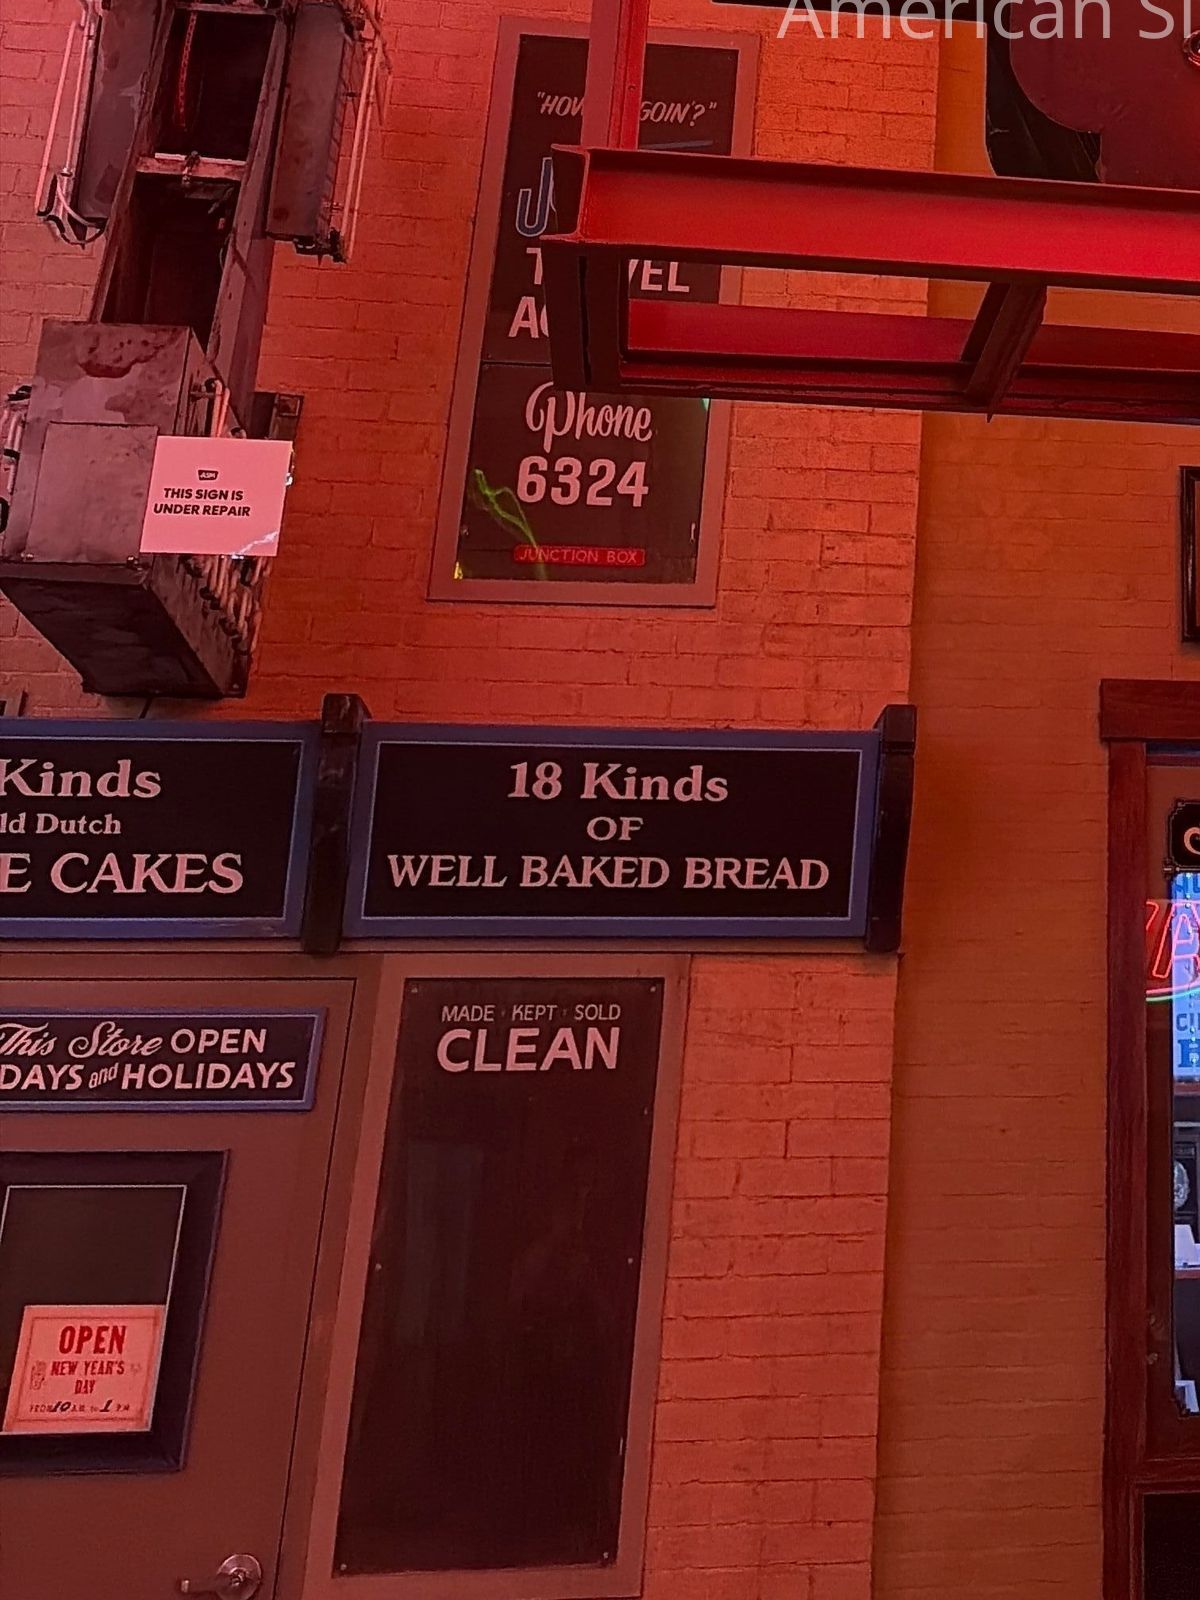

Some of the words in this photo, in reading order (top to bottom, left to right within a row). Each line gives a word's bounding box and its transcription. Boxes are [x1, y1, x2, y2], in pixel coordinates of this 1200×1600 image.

[525, 381, 653, 454] Phone
[163, 487, 193, 499] THIS
[195, 489, 229, 501] SIGN
[231, 490, 244, 501] IS
[516, 455, 649, 507] 6324
[153, 503, 200, 515] UNDER
[202, 504, 251, 517] REPAIR
[519, 549, 600, 563] JUNCTION
[606, 550, 637, 564] BOX
[0, 758, 162, 799] Kinds
[507, 761, 563, 801] 18
[580, 761, 729, 803] Kinds
[35, 812, 122, 835] Dutch
[586, 816, 644, 842] OF
[50, 852, 244, 894] CAKES
[387, 854, 508, 888] WELL
[519, 855, 670, 888] BAKED
[683, 857, 830, 890] BREAD
[441, 1004, 495, 1023] MADE
[511, 1004, 557, 1022] KEPT
[574, 1004, 622, 1021] SOLD
[0, 1022, 58, 1056] This
[68, 1020, 163, 1059] Store
[171, 1027, 267, 1055] OPEN
[436, 1026, 621, 1072] CLEAN
[88, 1062, 120, 1089] and
[121, 1061, 296, 1090] HOLIDAYS
[58, 1325, 127, 1355] OPEN
[50, 1361, 78, 1376] NEW
[83, 1360, 126, 1376] YEAR'S
[74, 1379, 96, 1394] DAY
